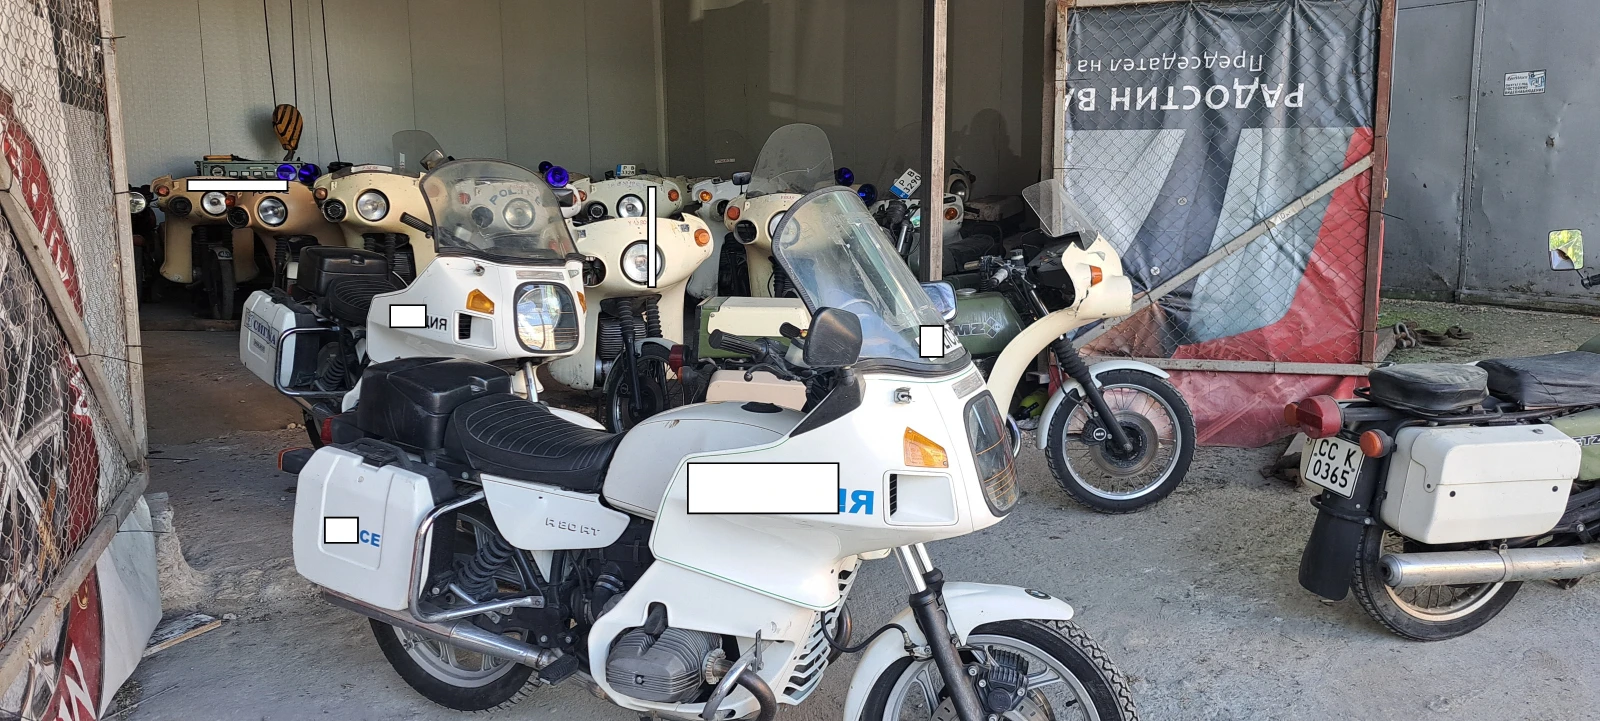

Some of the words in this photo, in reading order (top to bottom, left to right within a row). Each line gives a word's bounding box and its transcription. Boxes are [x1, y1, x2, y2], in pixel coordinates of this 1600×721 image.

[1077, 59, 1101, 72] на
[1110, 50, 1263, 72] Председател
[1110, 77, 1304, 111] РАДОСТИН
[1319, 439, 1338, 460] CC
[1344, 448, 1356, 468] K
[1313, 460, 1349, 487] 0365
